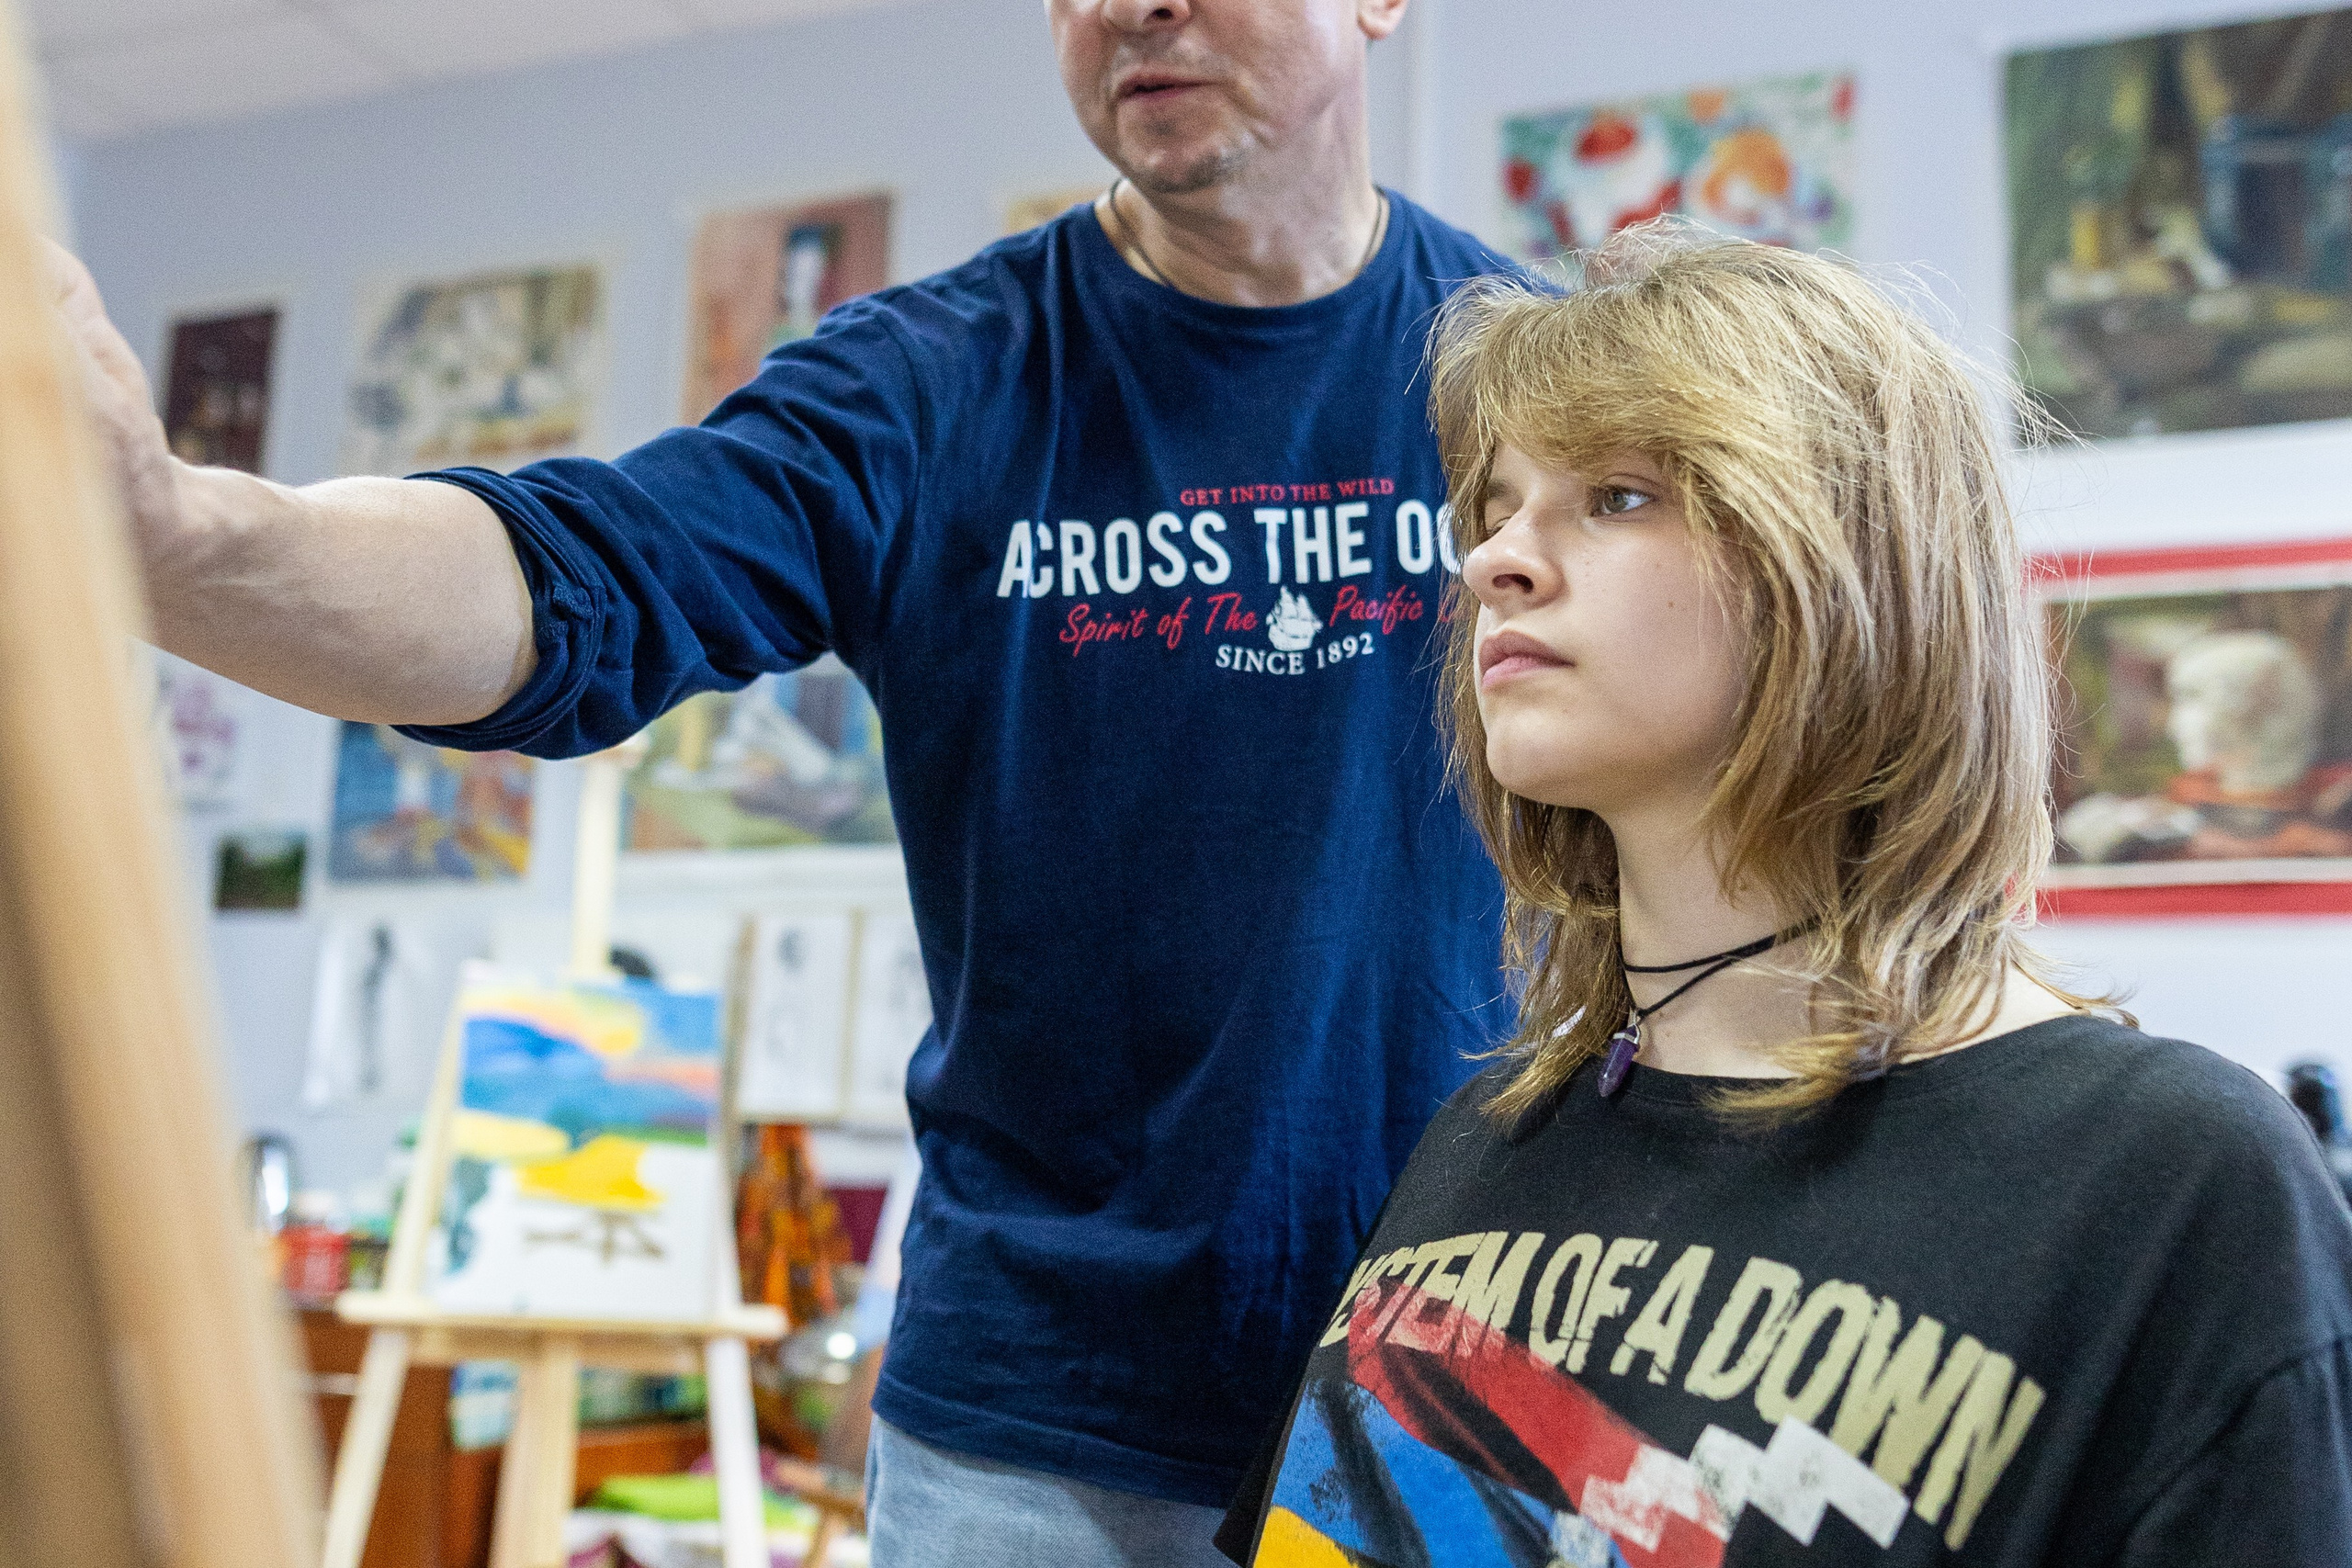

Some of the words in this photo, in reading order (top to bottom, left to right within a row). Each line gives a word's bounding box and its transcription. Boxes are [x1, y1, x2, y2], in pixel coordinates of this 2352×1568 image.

[1180, 488, 1223, 506] GET
[1229, 483, 1285, 504] INTO
[1288, 482, 1331, 502] THE
[1337, 477, 1395, 497] WILD
[997, 510, 1232, 598] ACROSS
[1253, 501, 1373, 584] THE
[1058, 602, 1148, 658] Spirit
[1157, 596, 1192, 650] of
[1204, 592, 1259, 636] The
[1329, 584, 1423, 635] Pacific
[1215, 644, 1306, 675] SINCE
[1316, 631, 1375, 670] 1892
[1318, 1230, 1545, 1358] YSTEM
[1528, 1232, 1659, 1374] OF
[1609, 1244, 1714, 1385] A
[1683, 1255, 2046, 1552] DOWN
